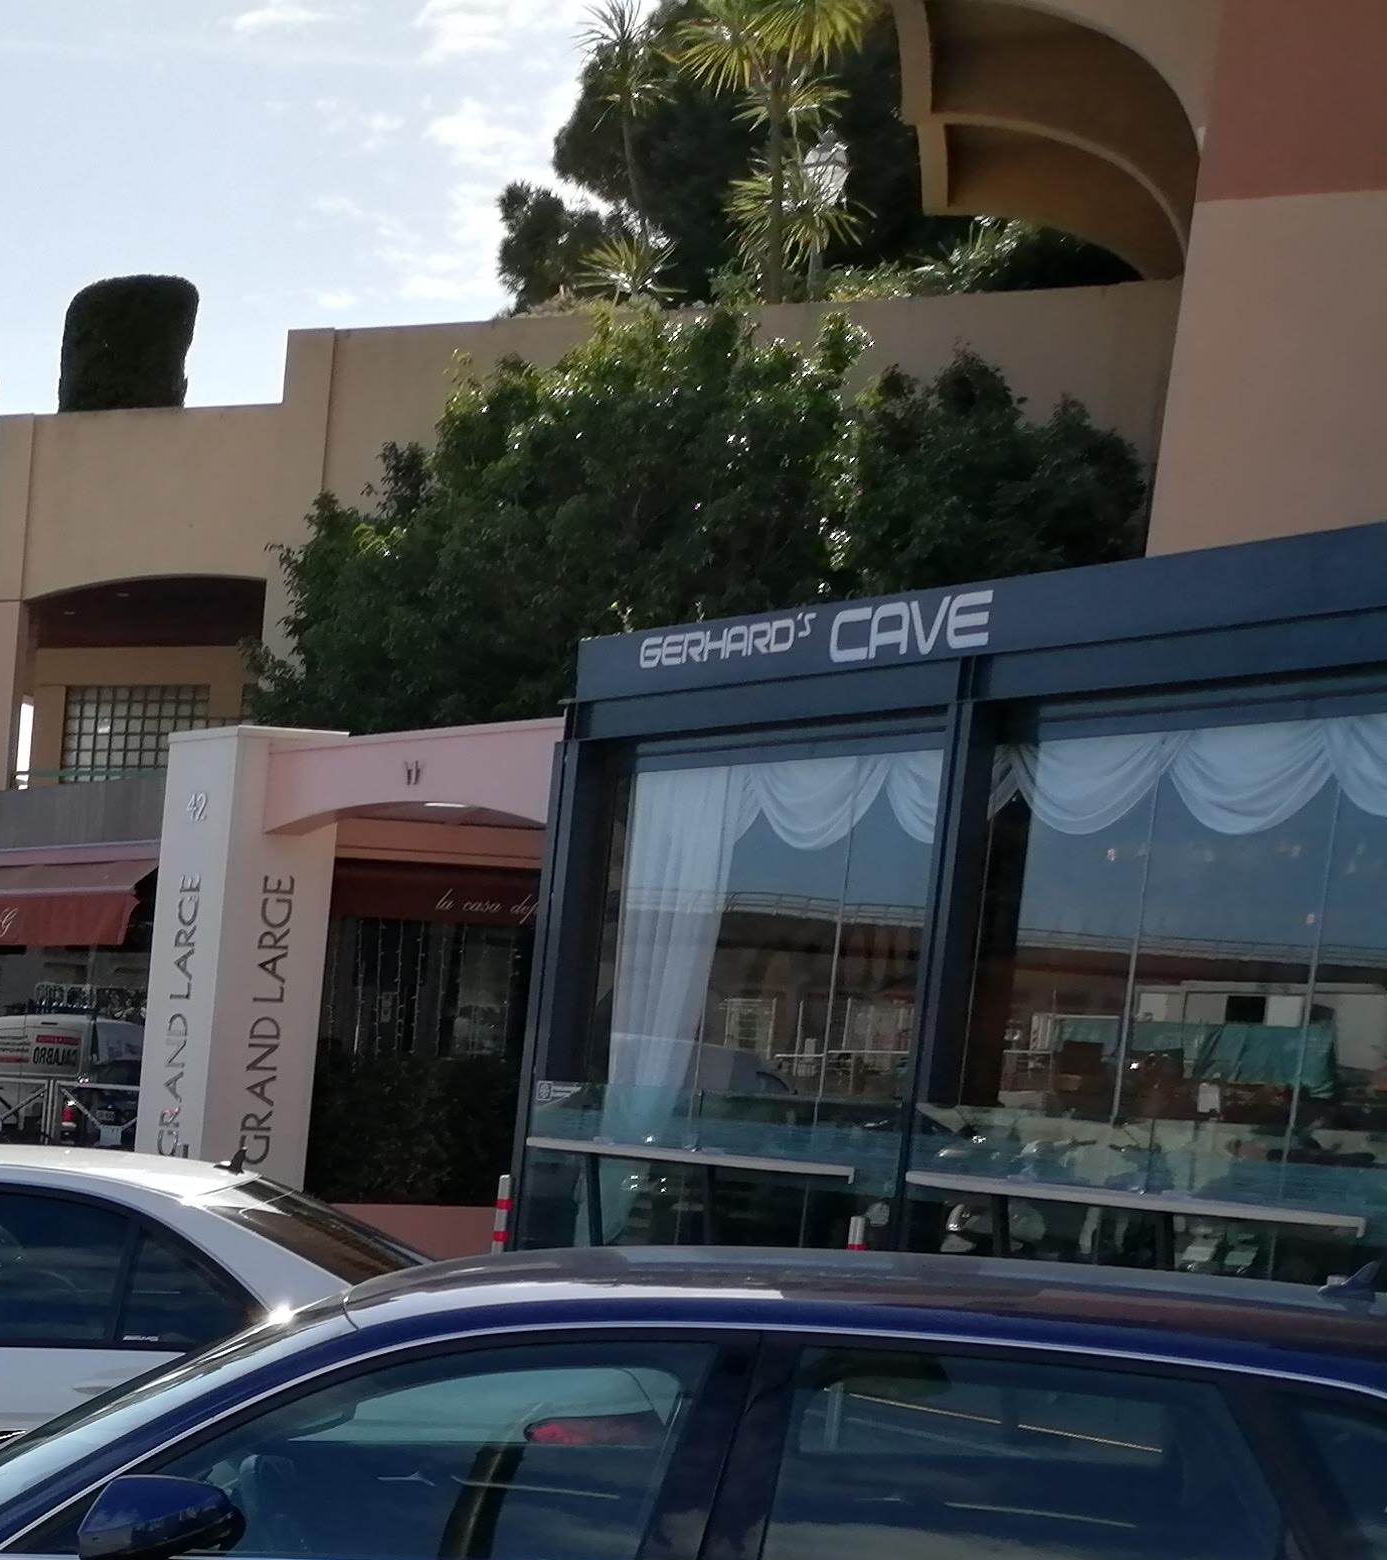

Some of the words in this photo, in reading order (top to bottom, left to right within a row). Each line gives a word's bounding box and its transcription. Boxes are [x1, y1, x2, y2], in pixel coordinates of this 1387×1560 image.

[829, 589, 994, 664] CAVE
[169, 874, 202, 1000] LARGE
[252, 875, 295, 1003] LARGE
[435, 888, 454, 911] la
[462, 901, 502, 912] casa
[157, 1013, 188, 1157] GRAND
[240, 1016, 281, 1165] GRAND
